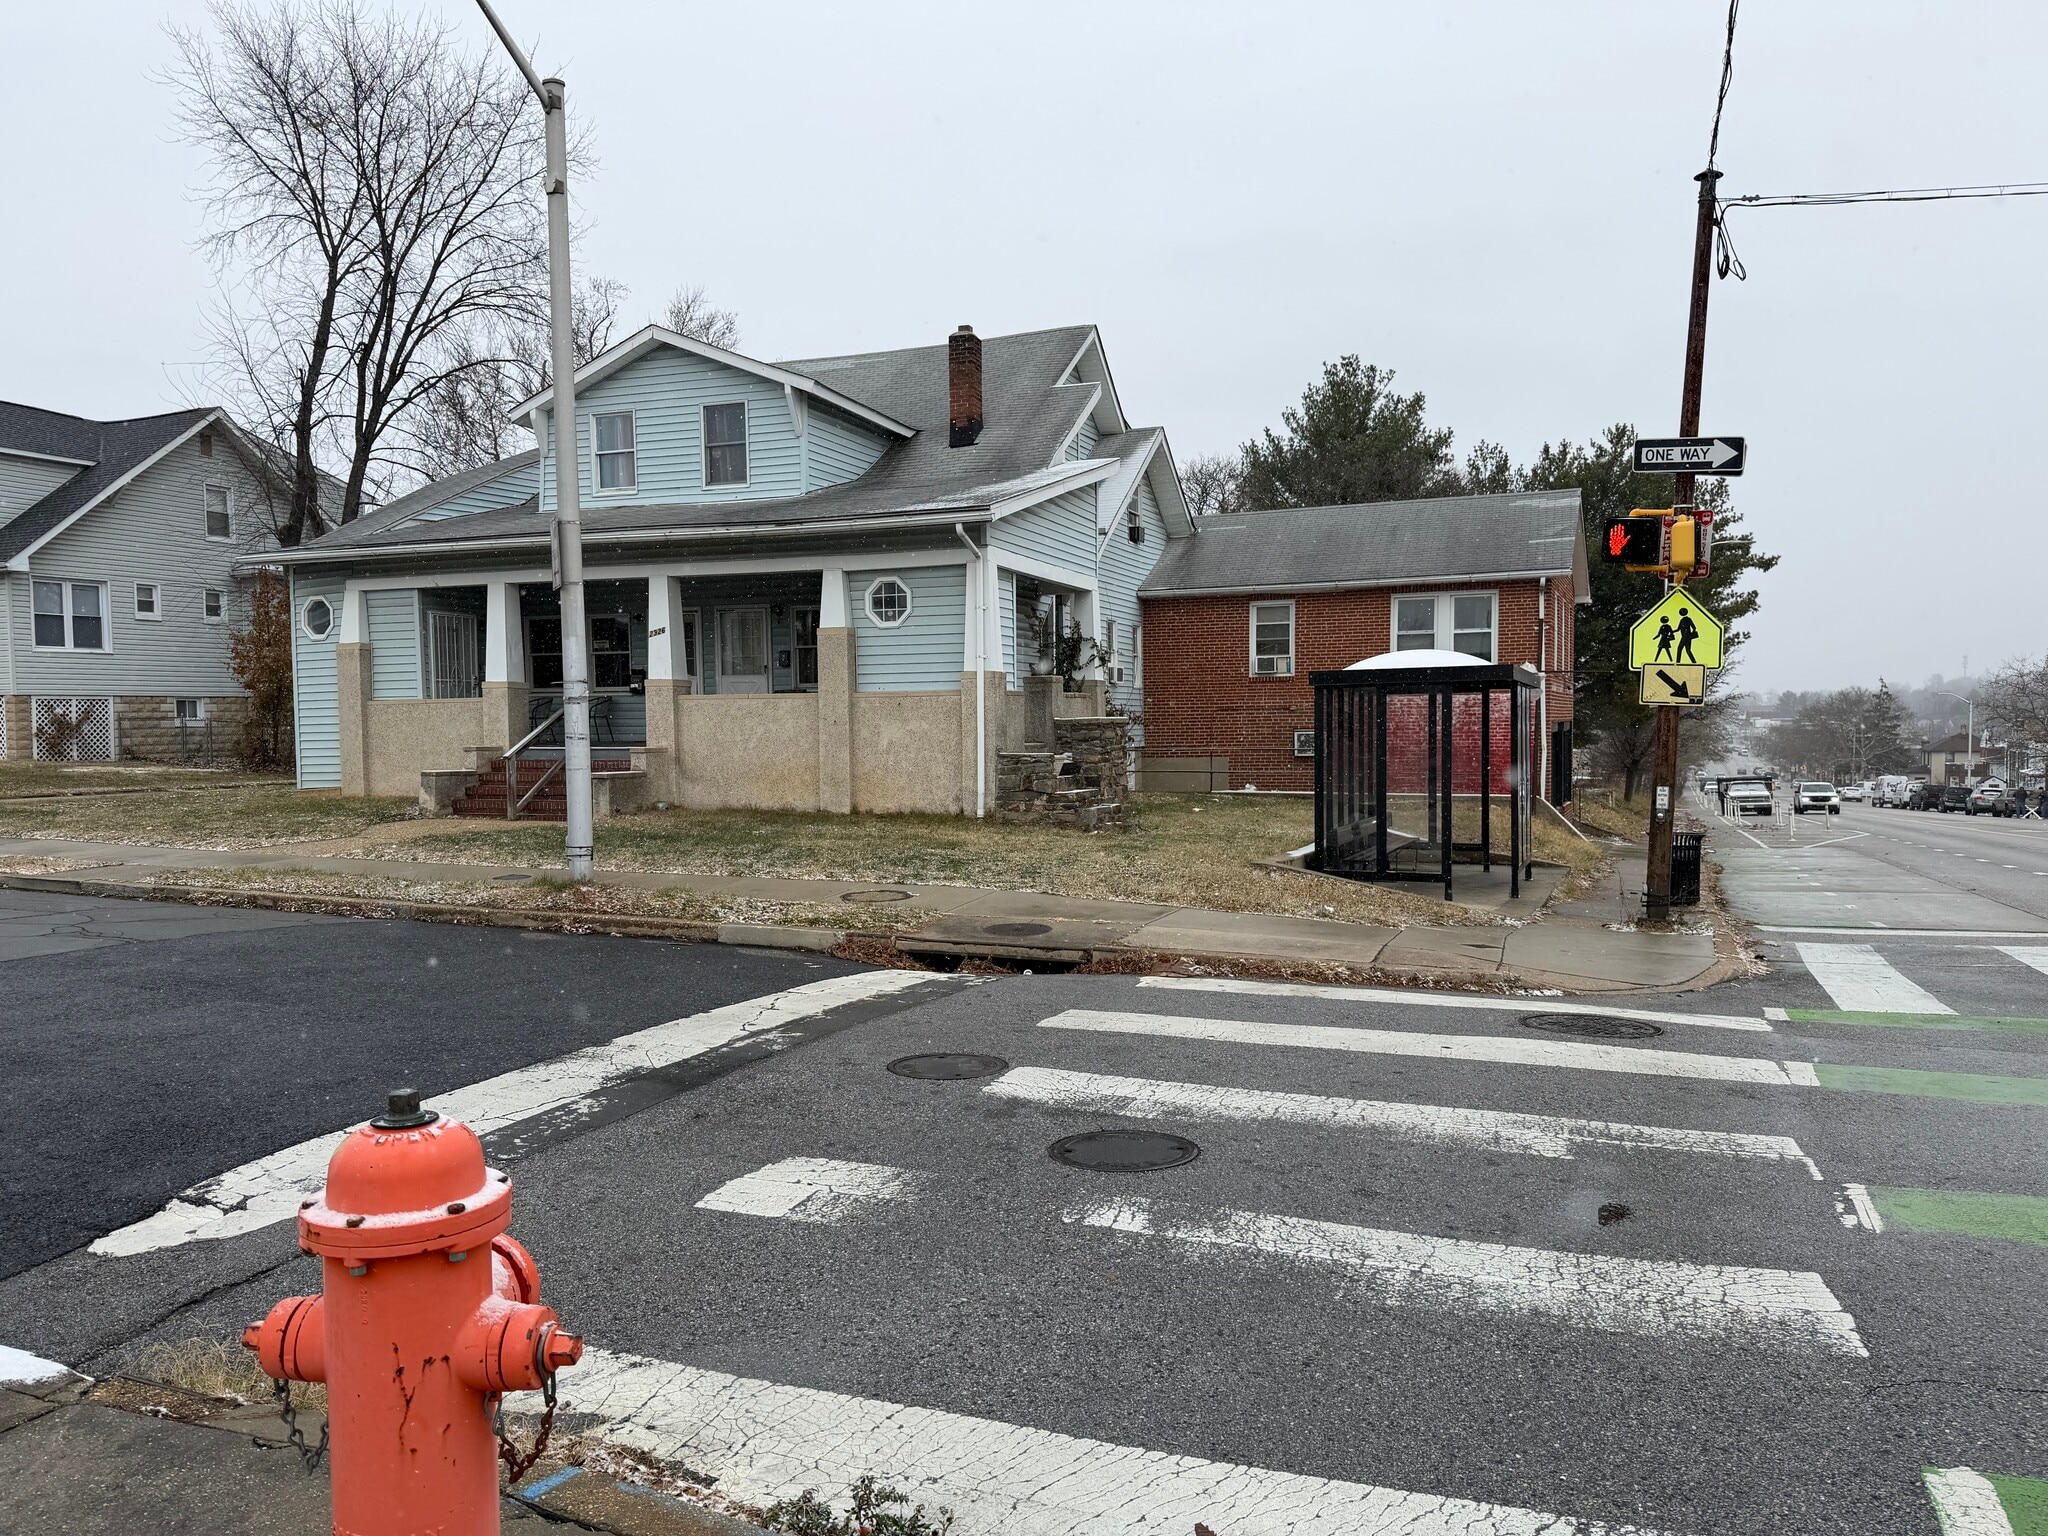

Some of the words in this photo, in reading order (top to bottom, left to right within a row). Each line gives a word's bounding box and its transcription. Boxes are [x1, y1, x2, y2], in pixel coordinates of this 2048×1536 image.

[1645, 448, 1675, 462] ONE
[1680, 447, 1711, 461] WAY
[374, 1129, 436, 1146] OPEN
